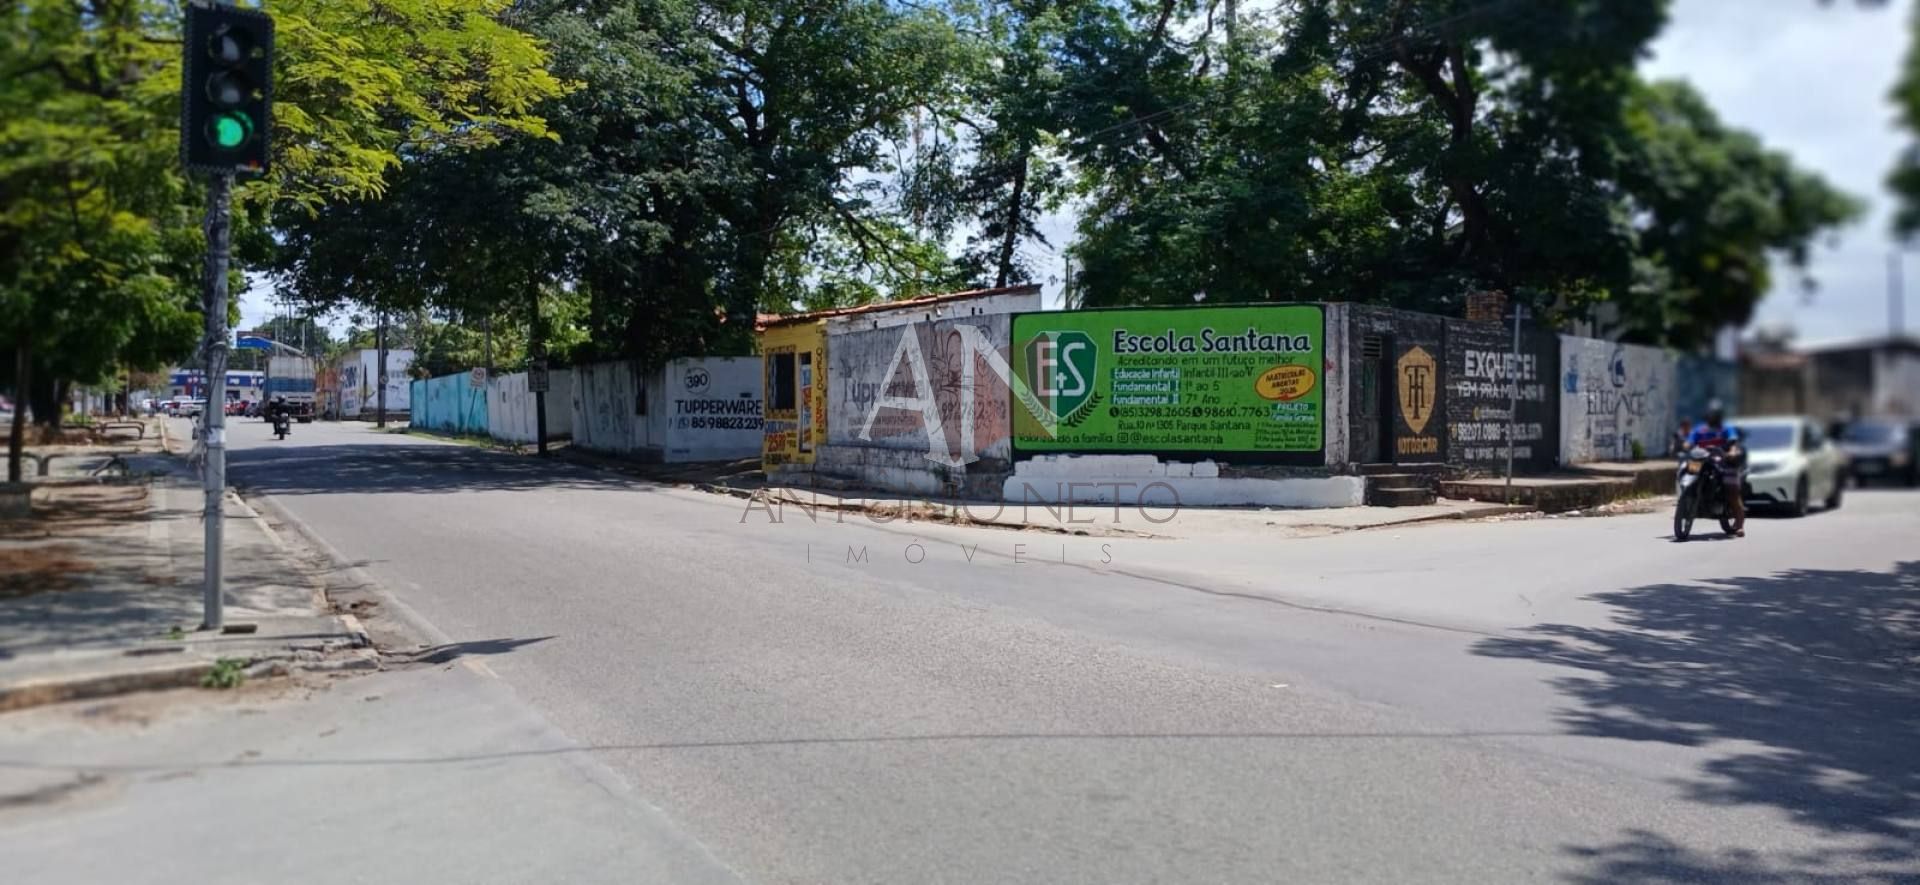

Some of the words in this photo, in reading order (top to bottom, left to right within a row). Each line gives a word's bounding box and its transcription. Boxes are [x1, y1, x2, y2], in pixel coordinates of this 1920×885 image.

[1113, 329, 1197, 354] Escola
[1200, 327, 1312, 354] Santana
[1118, 355, 1178, 366] Acreditando
[1182, 356, 1199, 366] em
[1203, 356, 1221, 366] um
[1222, 353, 1256, 366] futuro
[1258, 352, 1296, 365] melhor
[686, 373, 709, 389] 390
[1196, 382, 1209, 391] ao
[674, 399, 763, 415] TUPPERWARE
[1176, 419, 1207, 432] Parque
[1210, 419, 1251, 430] Santana
